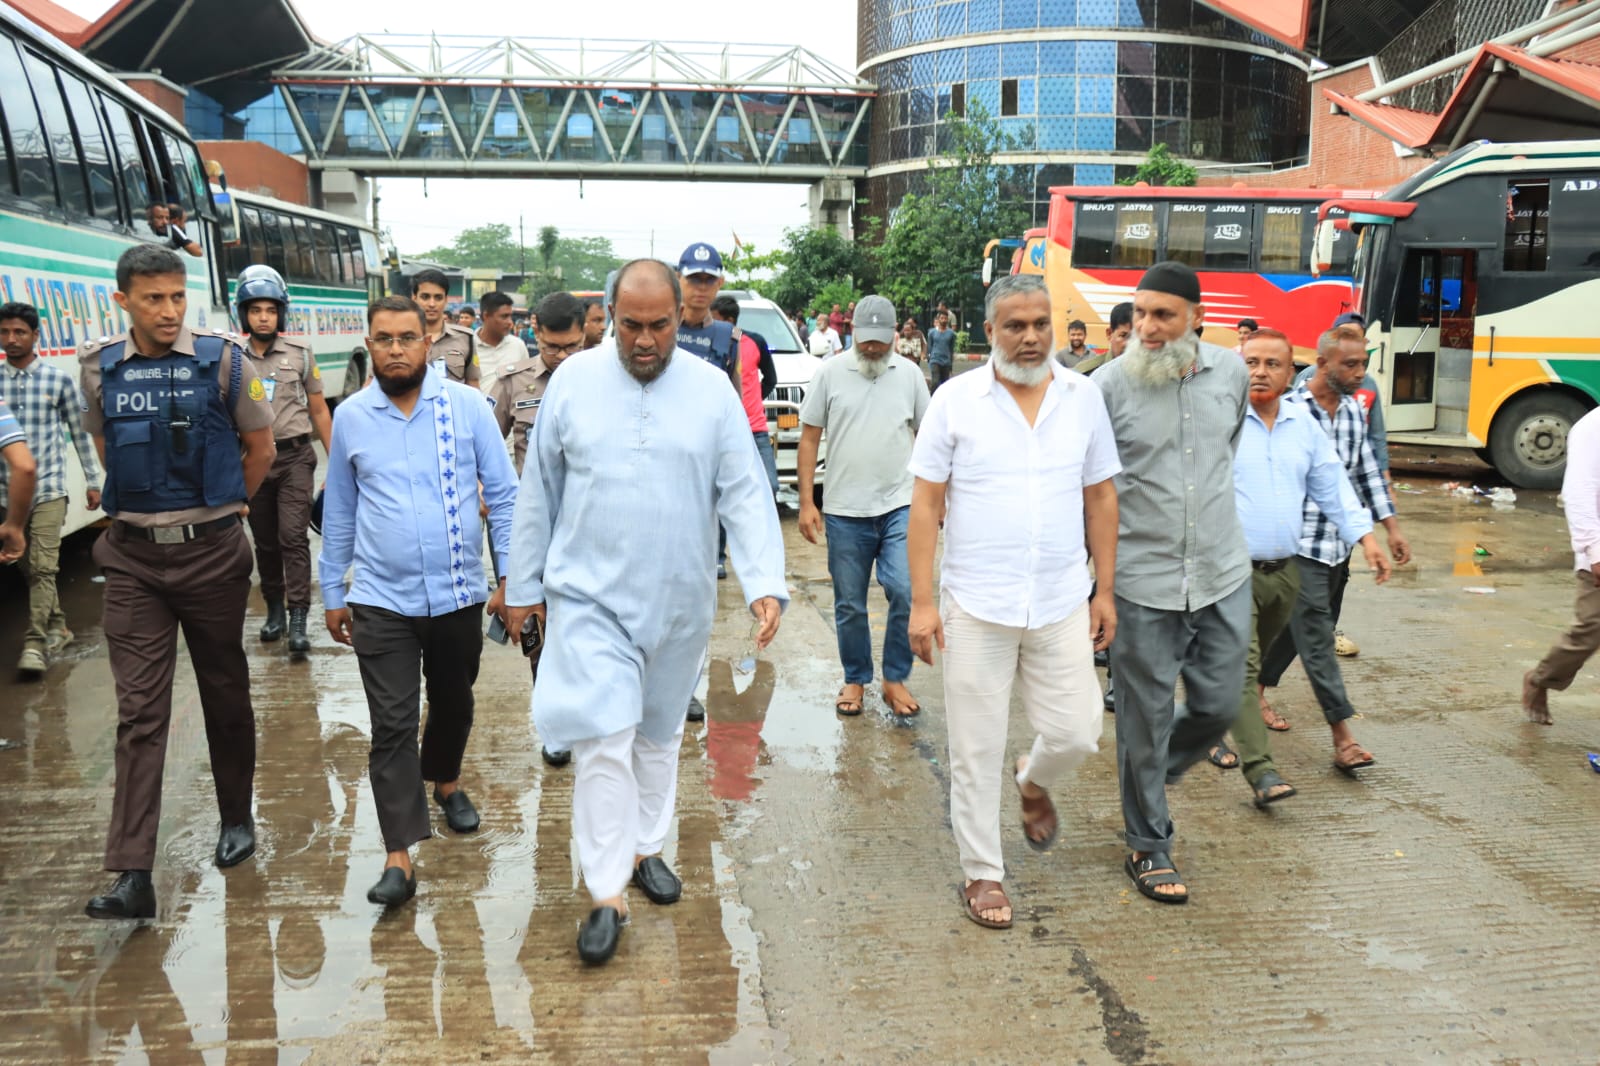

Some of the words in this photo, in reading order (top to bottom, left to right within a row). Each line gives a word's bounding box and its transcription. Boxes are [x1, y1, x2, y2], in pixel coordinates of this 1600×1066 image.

[1562, 179, 1600, 191] AD
[1082, 203, 1115, 212] SHUVO
[1121, 203, 1154, 212] JATRA
[1172, 204, 1207, 213] SHUVO
[1212, 204, 1246, 213] JATRA
[1266, 206, 1302, 215] SHUVO
[315, 307, 364, 335] EXPRESS
